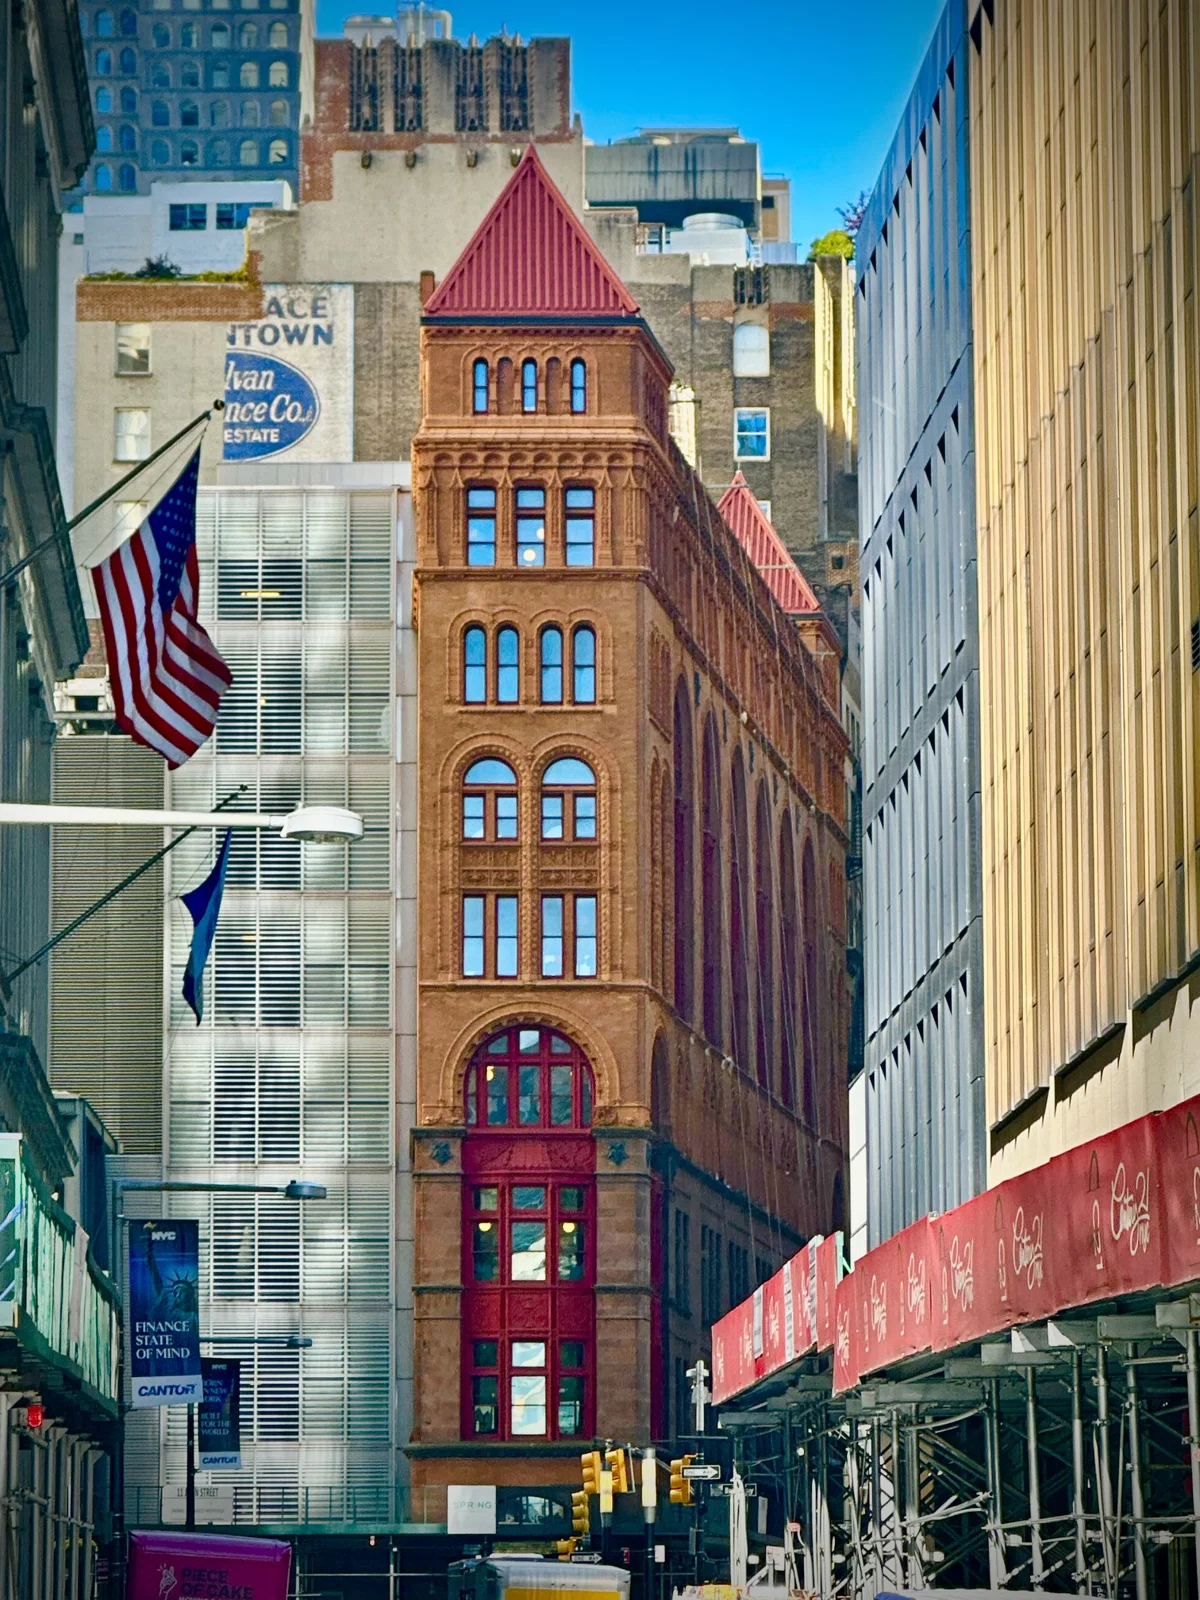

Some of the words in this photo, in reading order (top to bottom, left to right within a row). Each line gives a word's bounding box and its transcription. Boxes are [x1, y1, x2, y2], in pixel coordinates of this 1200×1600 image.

[267, 296, 328, 319] ACE
[223, 428, 280, 443] ESTATE
[151, 1231, 176, 1240] NYC
[135, 1320, 190, 1333] FINANCE
[135, 1334, 173, 1346] STATE
[135, 1348, 153, 1360] OF
[155, 1347, 190, 1359] MIND
[138, 1384, 197, 1397] CANTOR
[201, 1428, 229, 1436] WORLD
[200, 1487, 219, 1497] STREET
[181, 1568, 228, 1583] PIECE
[181, 1583, 204, 1595] OF
[206, 1584, 253, 1600] CAKE
